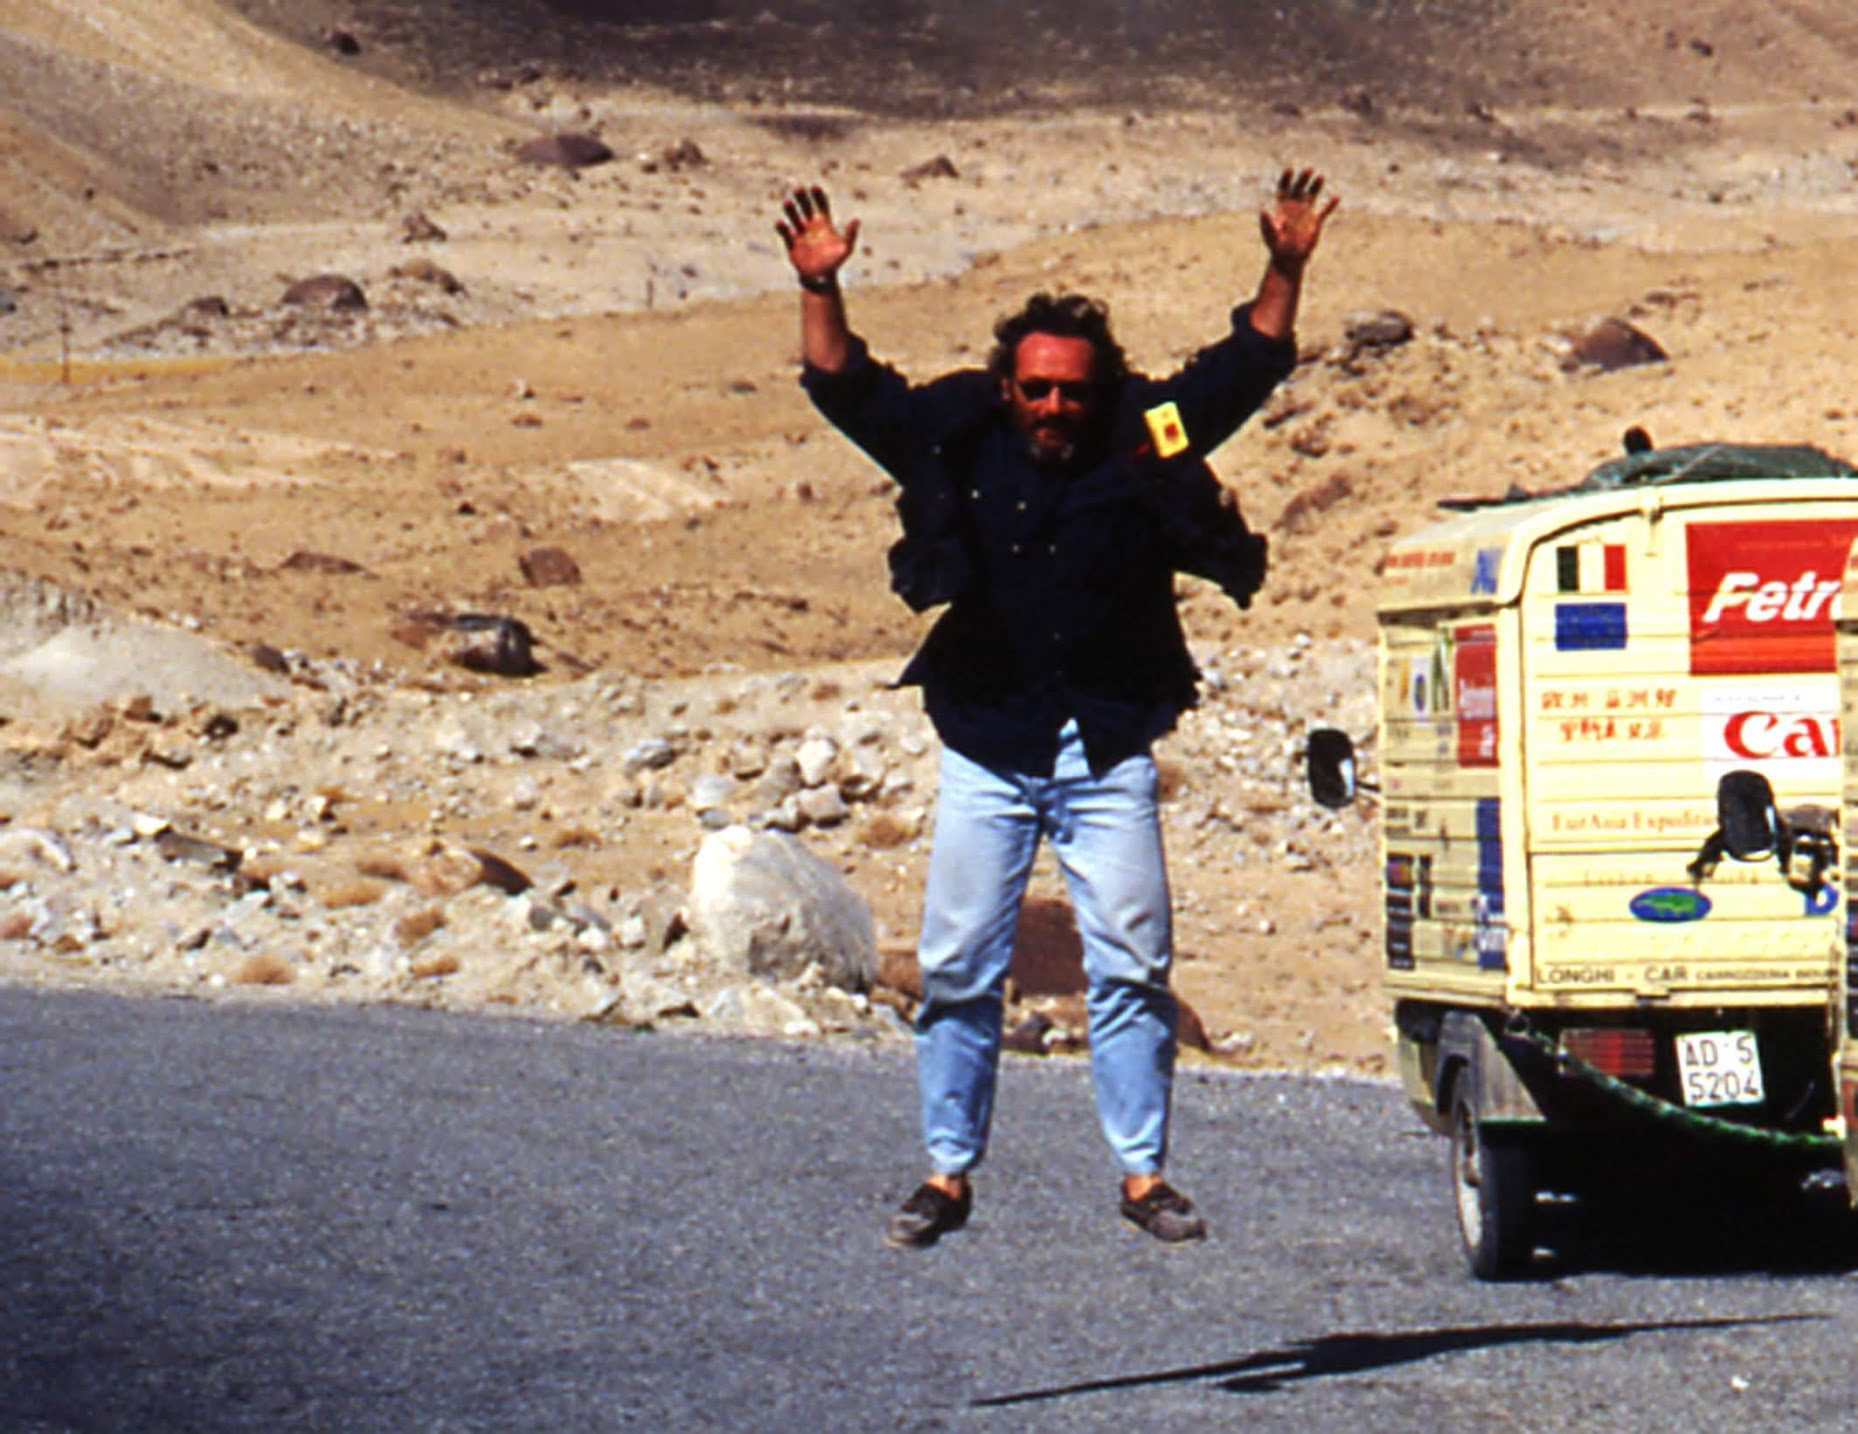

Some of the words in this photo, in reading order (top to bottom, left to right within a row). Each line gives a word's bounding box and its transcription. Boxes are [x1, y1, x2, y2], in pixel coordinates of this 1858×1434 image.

[1644, 965, 1688, 983] CAR
[1686, 1039, 1718, 1067] AD
[1688, 1069, 1759, 1101] 5204
